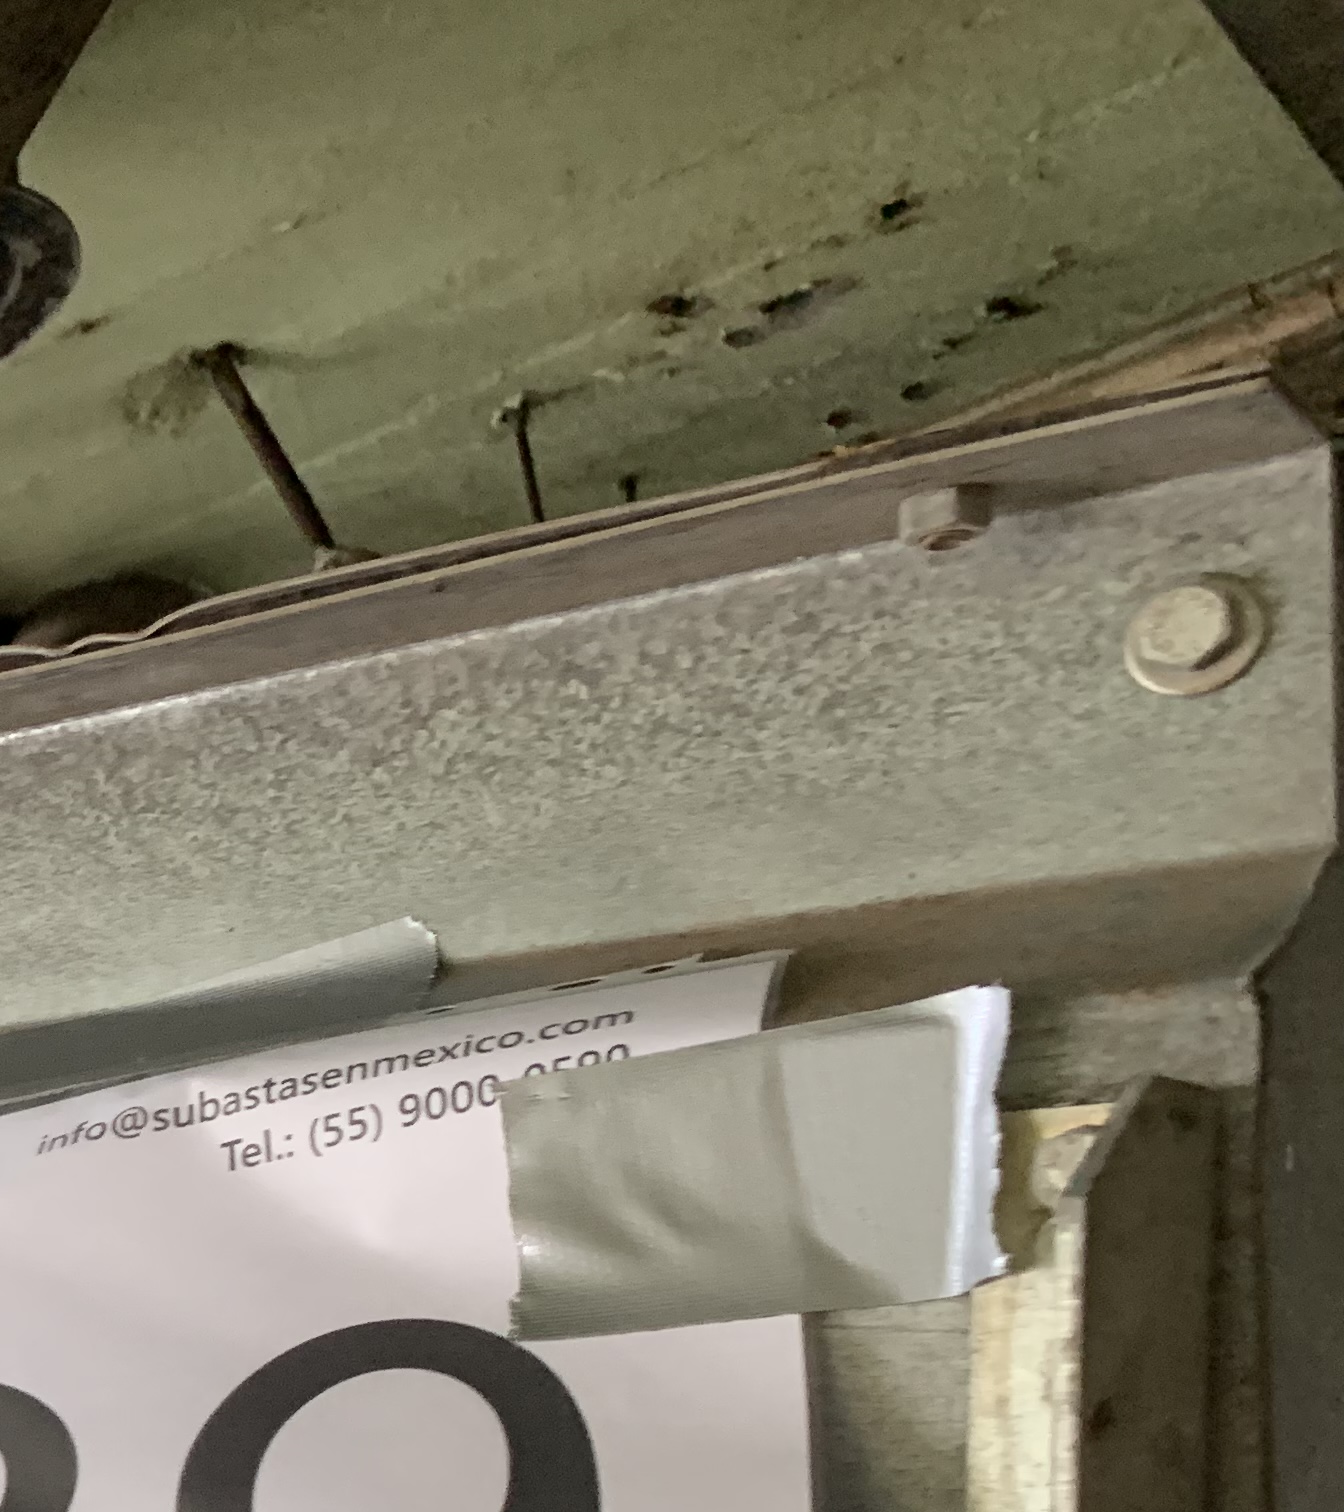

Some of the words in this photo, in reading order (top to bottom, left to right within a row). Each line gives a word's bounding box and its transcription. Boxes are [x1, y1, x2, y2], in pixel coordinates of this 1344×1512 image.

[35, 1008, 636, 1157] info@subastasenmexico.com
[219, 1127, 295, 1172] Tel.:
[308, 1102, 385, 1158] (55)
